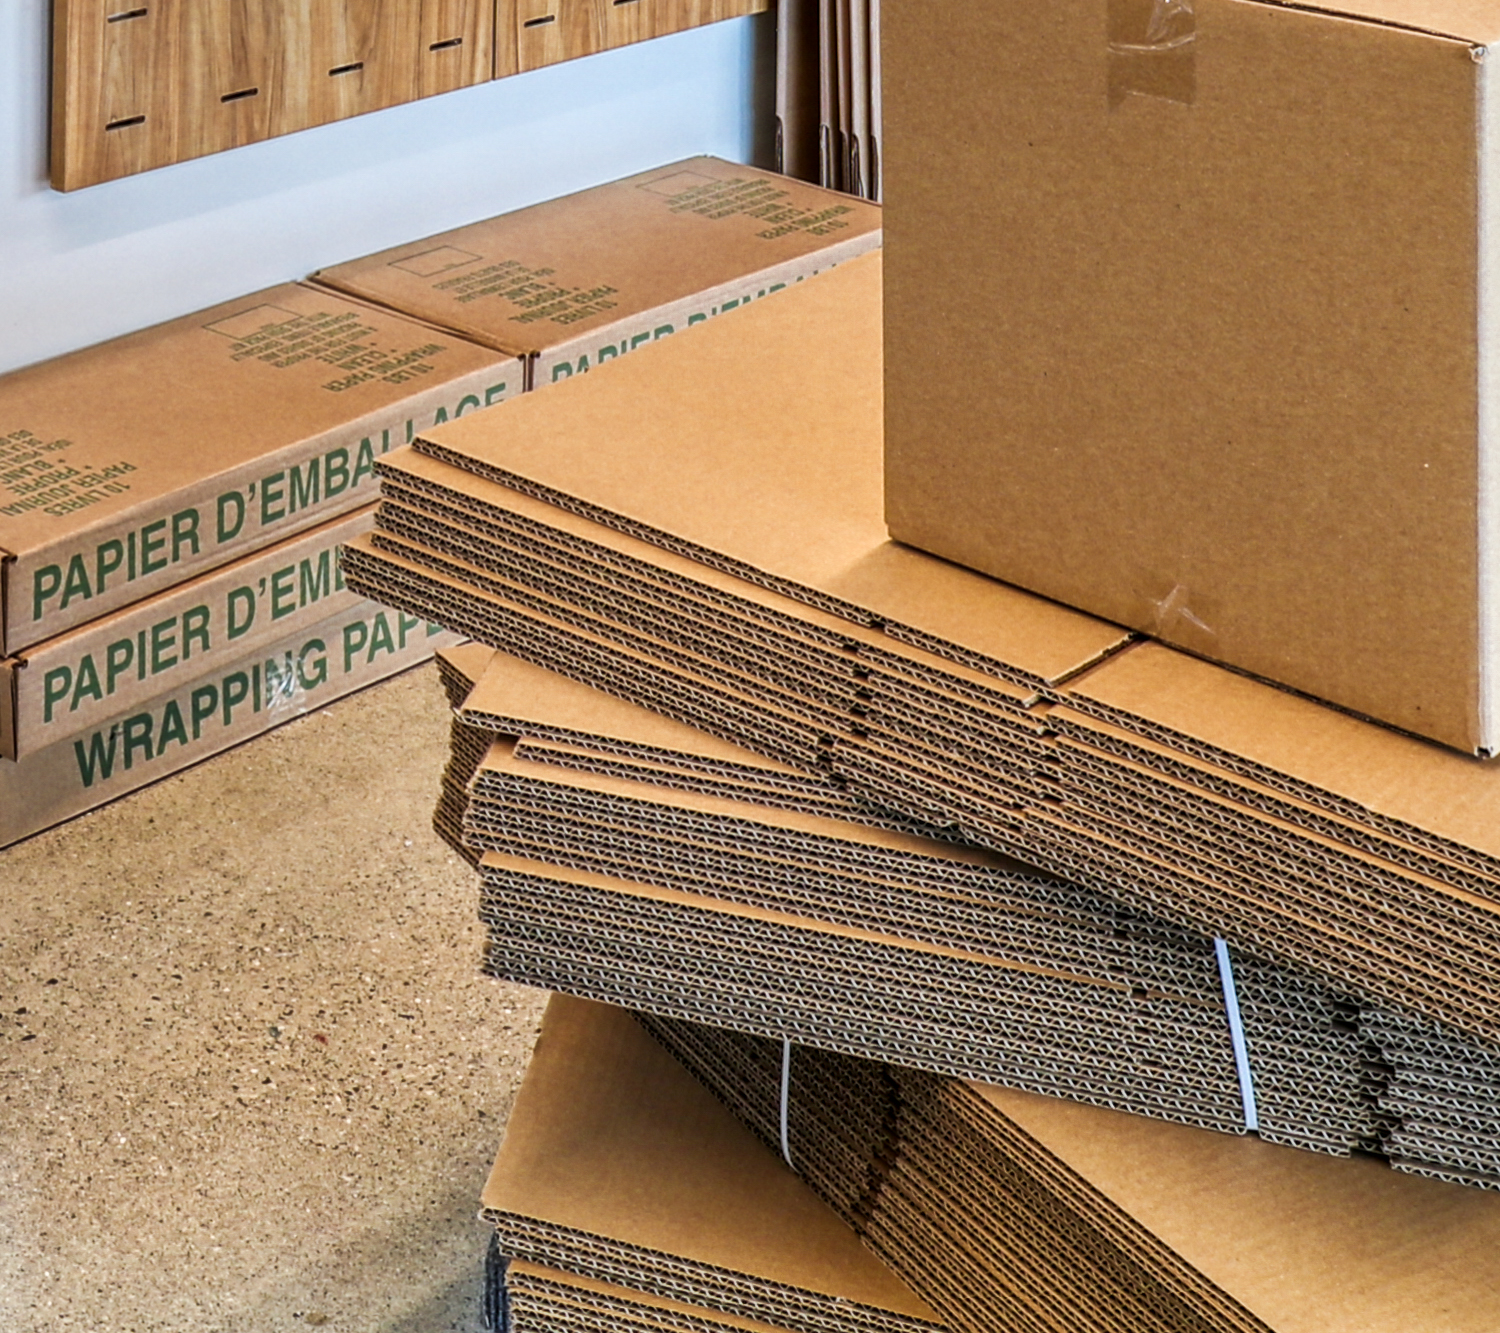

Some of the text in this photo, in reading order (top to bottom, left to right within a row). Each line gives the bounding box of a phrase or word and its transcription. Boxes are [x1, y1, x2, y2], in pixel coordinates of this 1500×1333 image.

[33, 507, 200, 621] PAPIER
[44, 605, 210, 723] PAPIER
[74, 639, 327, 788] WRAPPING
